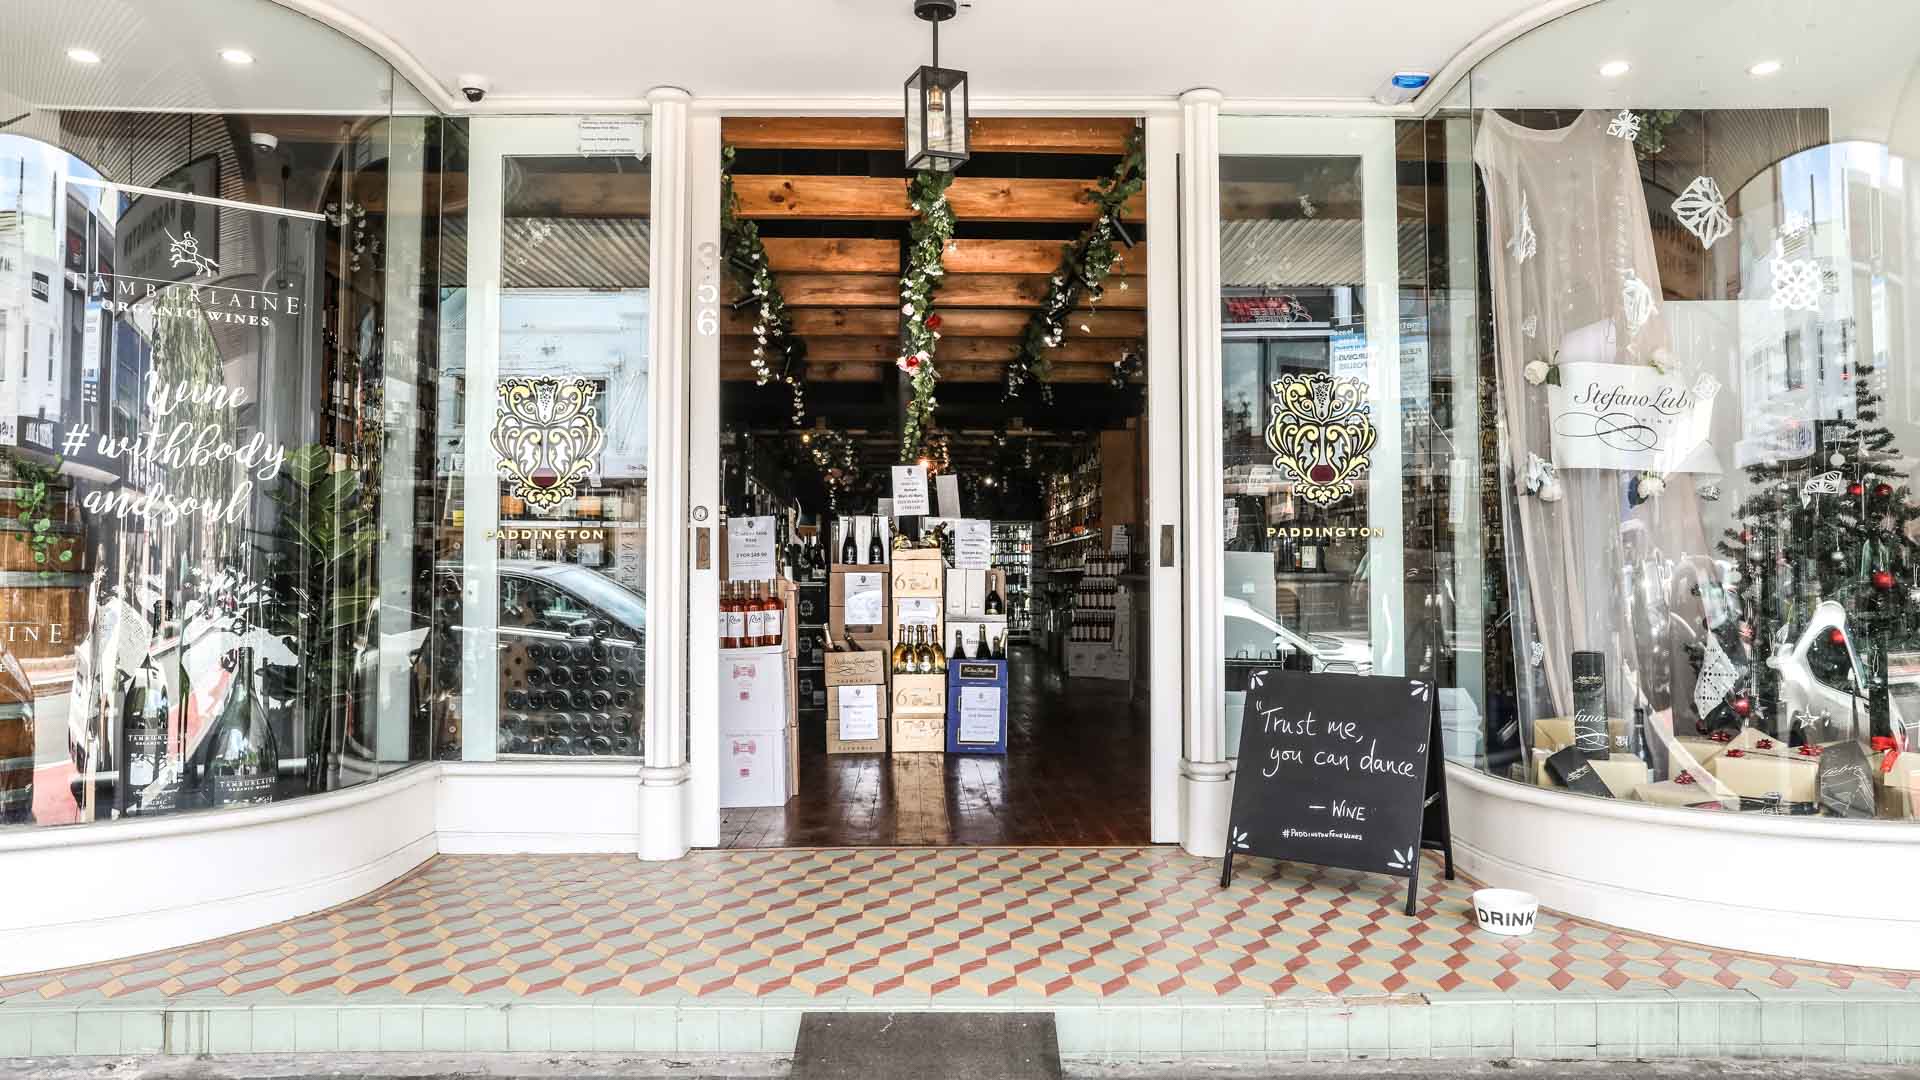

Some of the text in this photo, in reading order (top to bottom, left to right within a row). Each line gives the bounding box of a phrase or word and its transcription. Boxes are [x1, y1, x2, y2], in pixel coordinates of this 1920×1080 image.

[66, 271, 300, 315] TAMBURLAINE
[101, 300, 270, 327] ORGANIC WINES
[1574, 382, 1649, 413] Stefano
[487, 529, 604, 541] PADDINGTON
[1266, 527, 1384, 538] PADDINGTON
[1327, 721, 1364, 743] me,
[1263, 747, 1303, 777] you
[1314, 751, 1350, 772] can
[1332, 799, 1366, 821] WINE
[1478, 907, 1535, 927] DRINK
